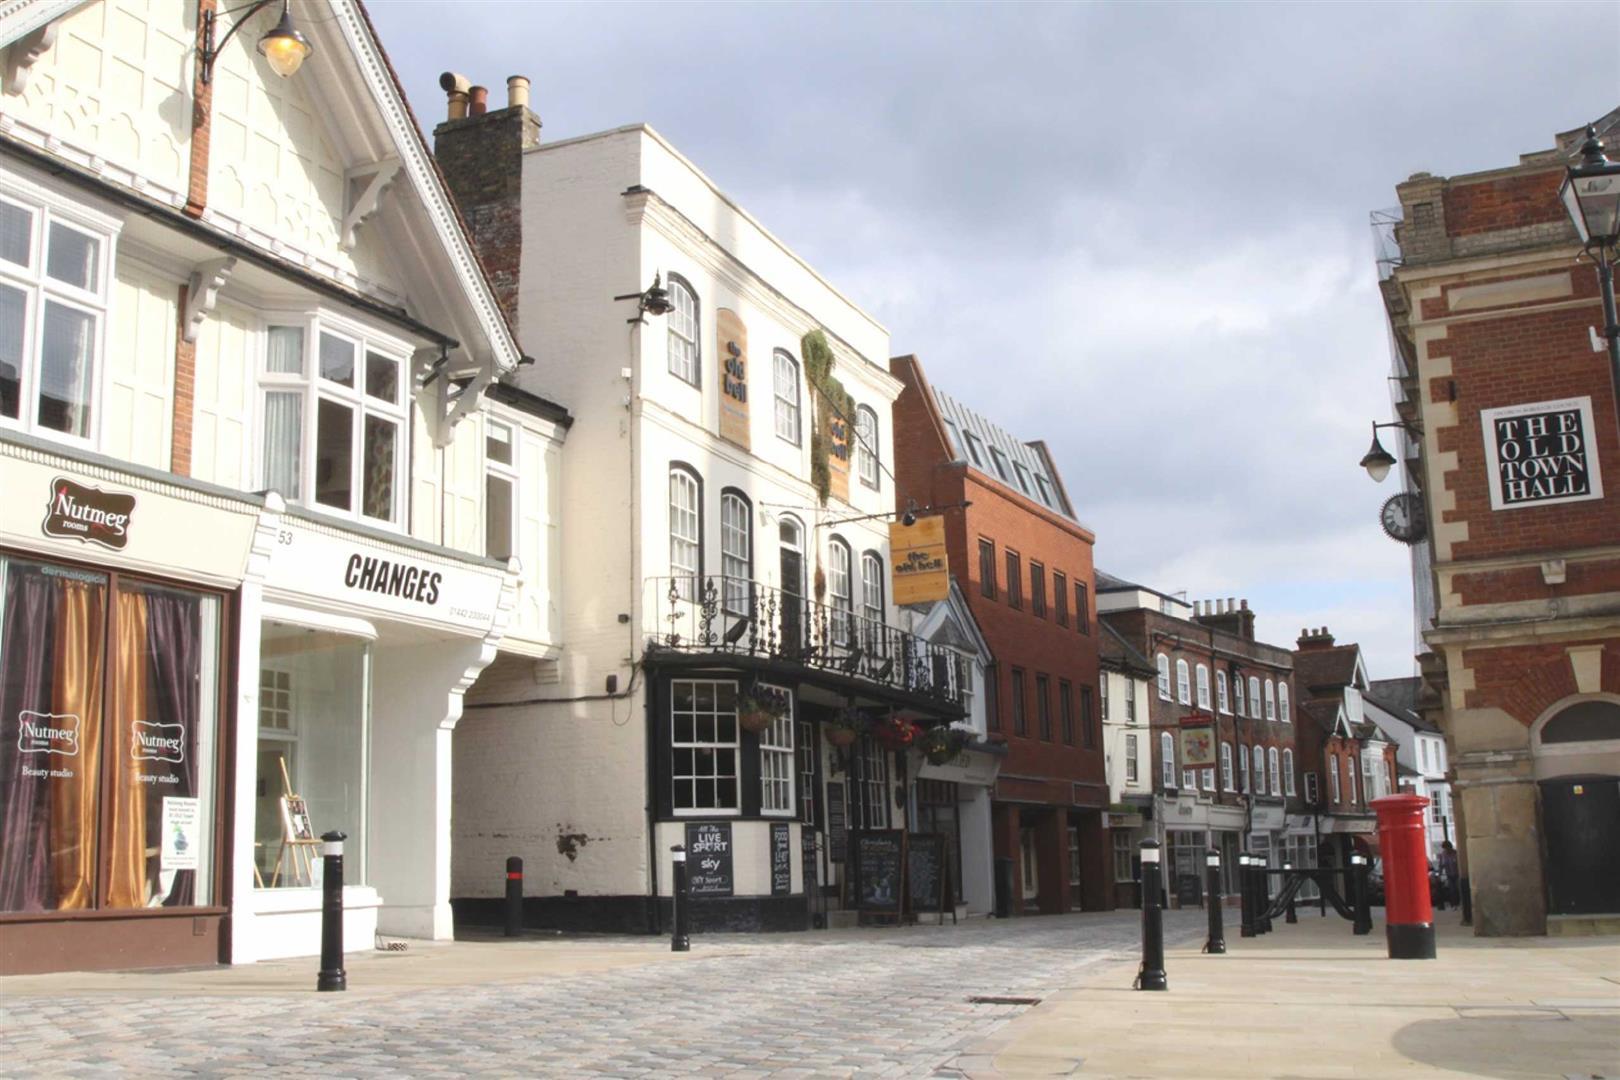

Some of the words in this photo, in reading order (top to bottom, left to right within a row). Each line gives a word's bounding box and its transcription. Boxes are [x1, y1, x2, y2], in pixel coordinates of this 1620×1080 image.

[1499, 413, 1578, 440] THE
[1500, 433, 1581, 460] OLD
[1500, 452, 1585, 480] TOWN
[1504, 473, 1586, 501] HALL
[54, 493, 128, 536] Nutmeg
[62, 520, 89, 532] rooms
[277, 530, 293, 546] 53
[344, 553, 443, 606] CHANGES
[24, 721, 74, 745] Nutmeg
[136, 731, 179, 753] Nutmeg
[22, 765, 48, 779] Beauty
[50, 768, 74, 778] studio
[692, 841, 728, 853] SPORT
[697, 833, 722, 843] LIVE
[700, 858, 721, 871] sky
